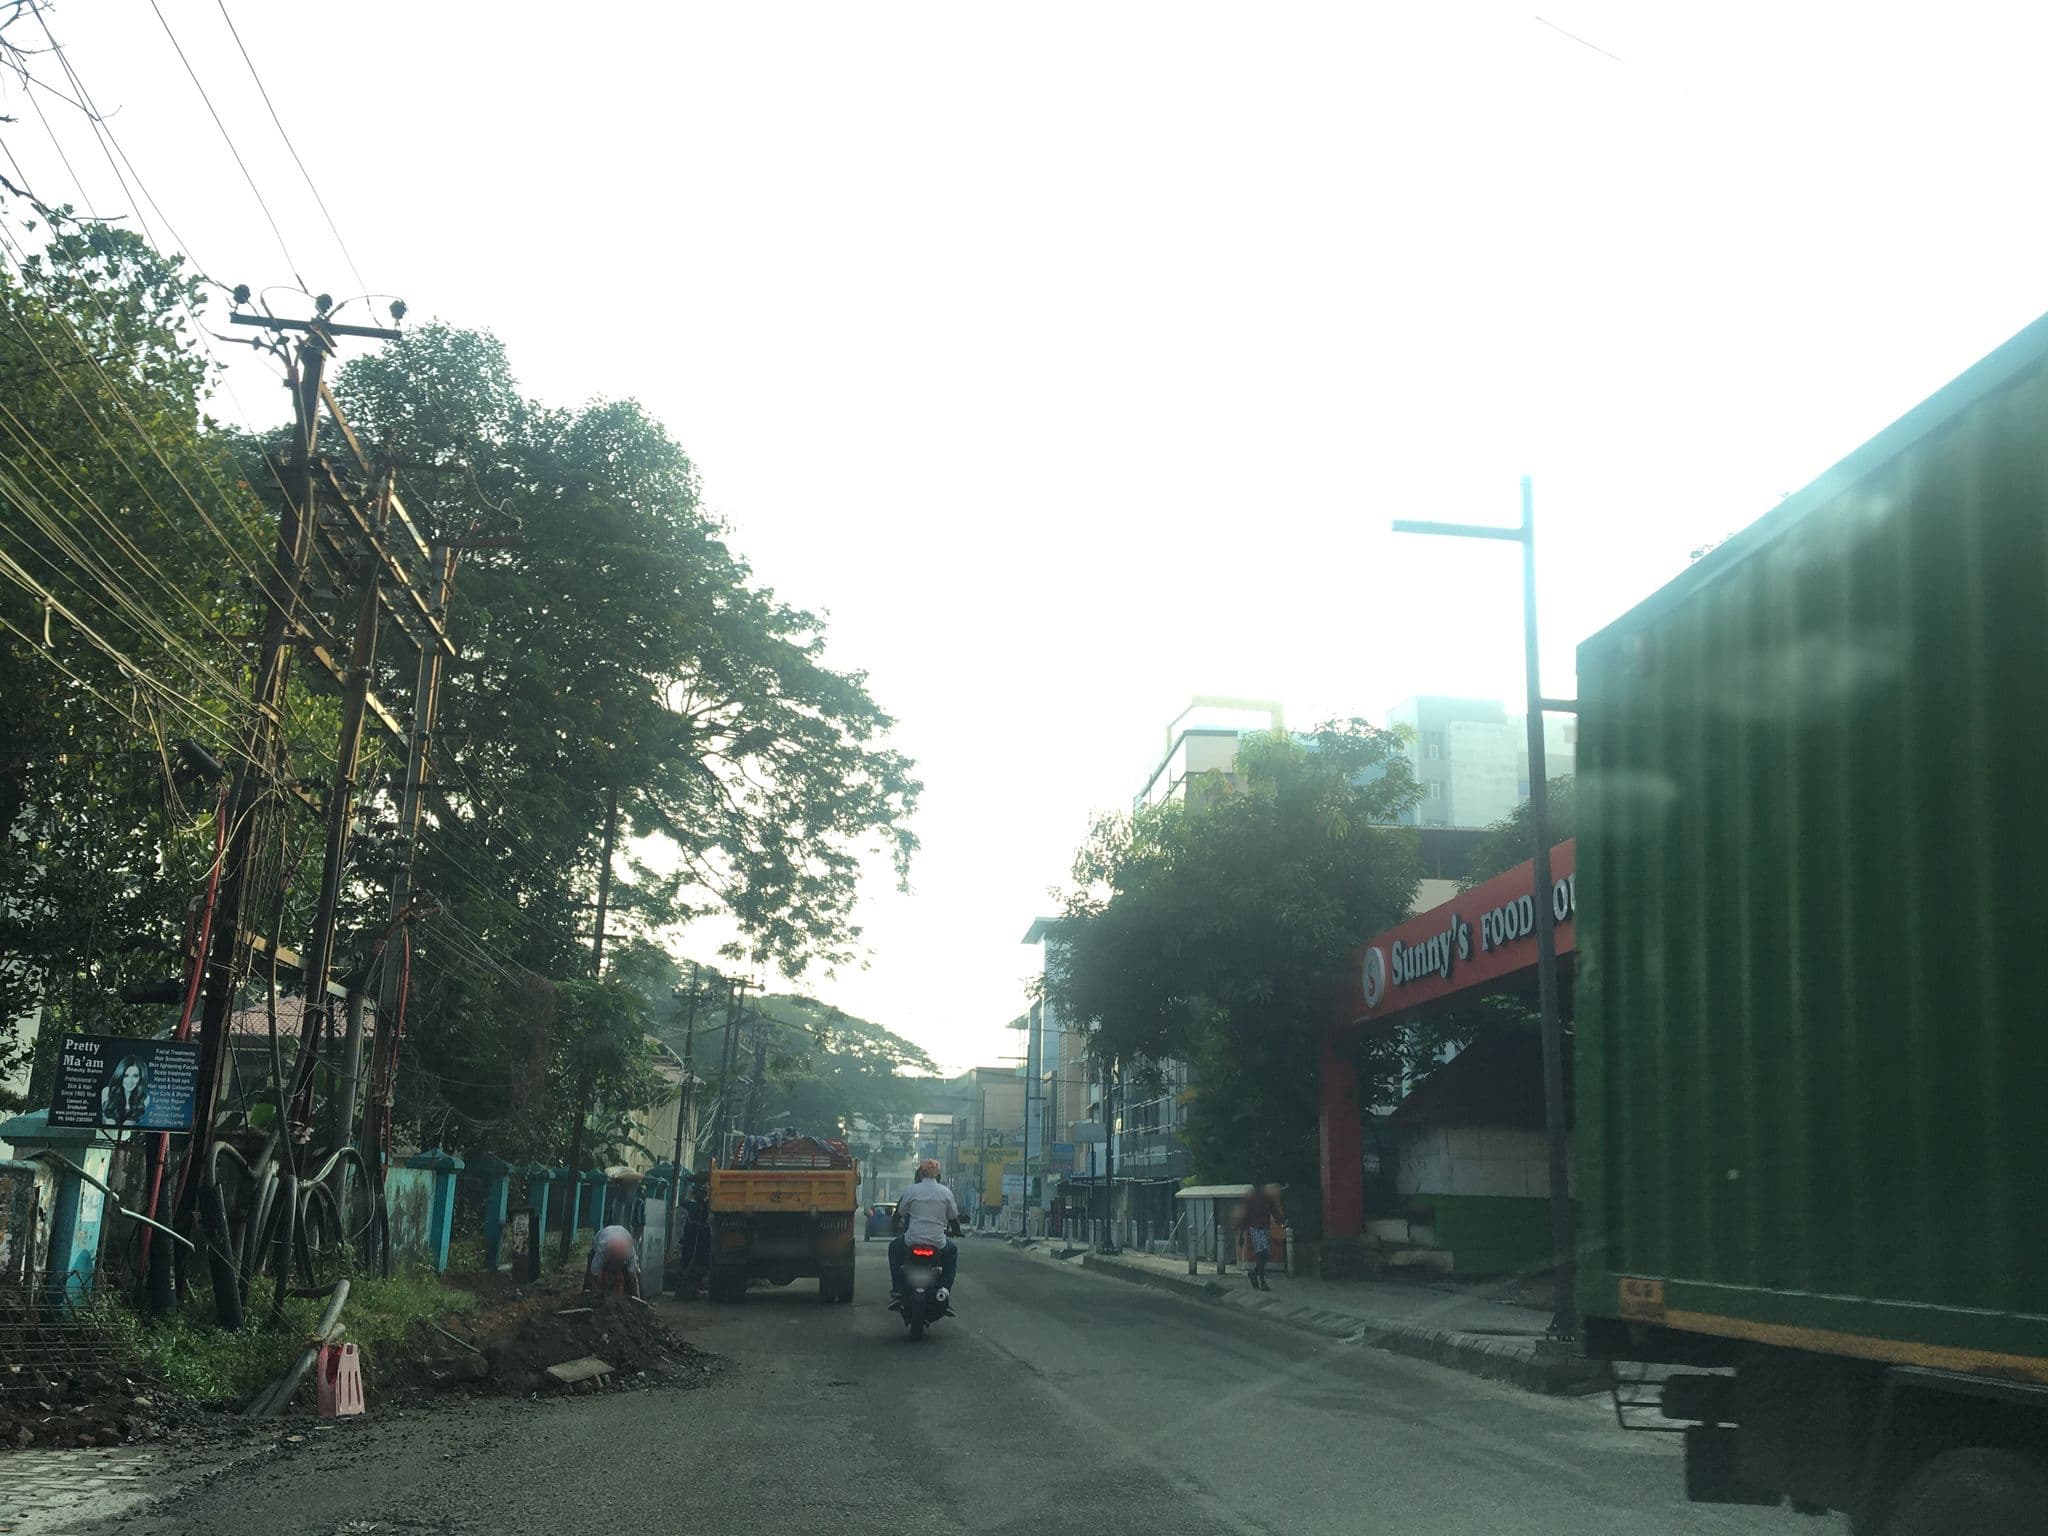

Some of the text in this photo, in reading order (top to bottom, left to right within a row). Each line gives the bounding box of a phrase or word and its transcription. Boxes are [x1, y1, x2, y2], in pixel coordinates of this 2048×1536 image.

[1391, 913, 1469, 985] Sunny's
[1481, 894, 1534, 951] FOOD
[65, 1038, 100, 1055] Pretty
[63, 1054, 104, 1068] Ma'am
[66, 1066, 86, 1074] Beauty
